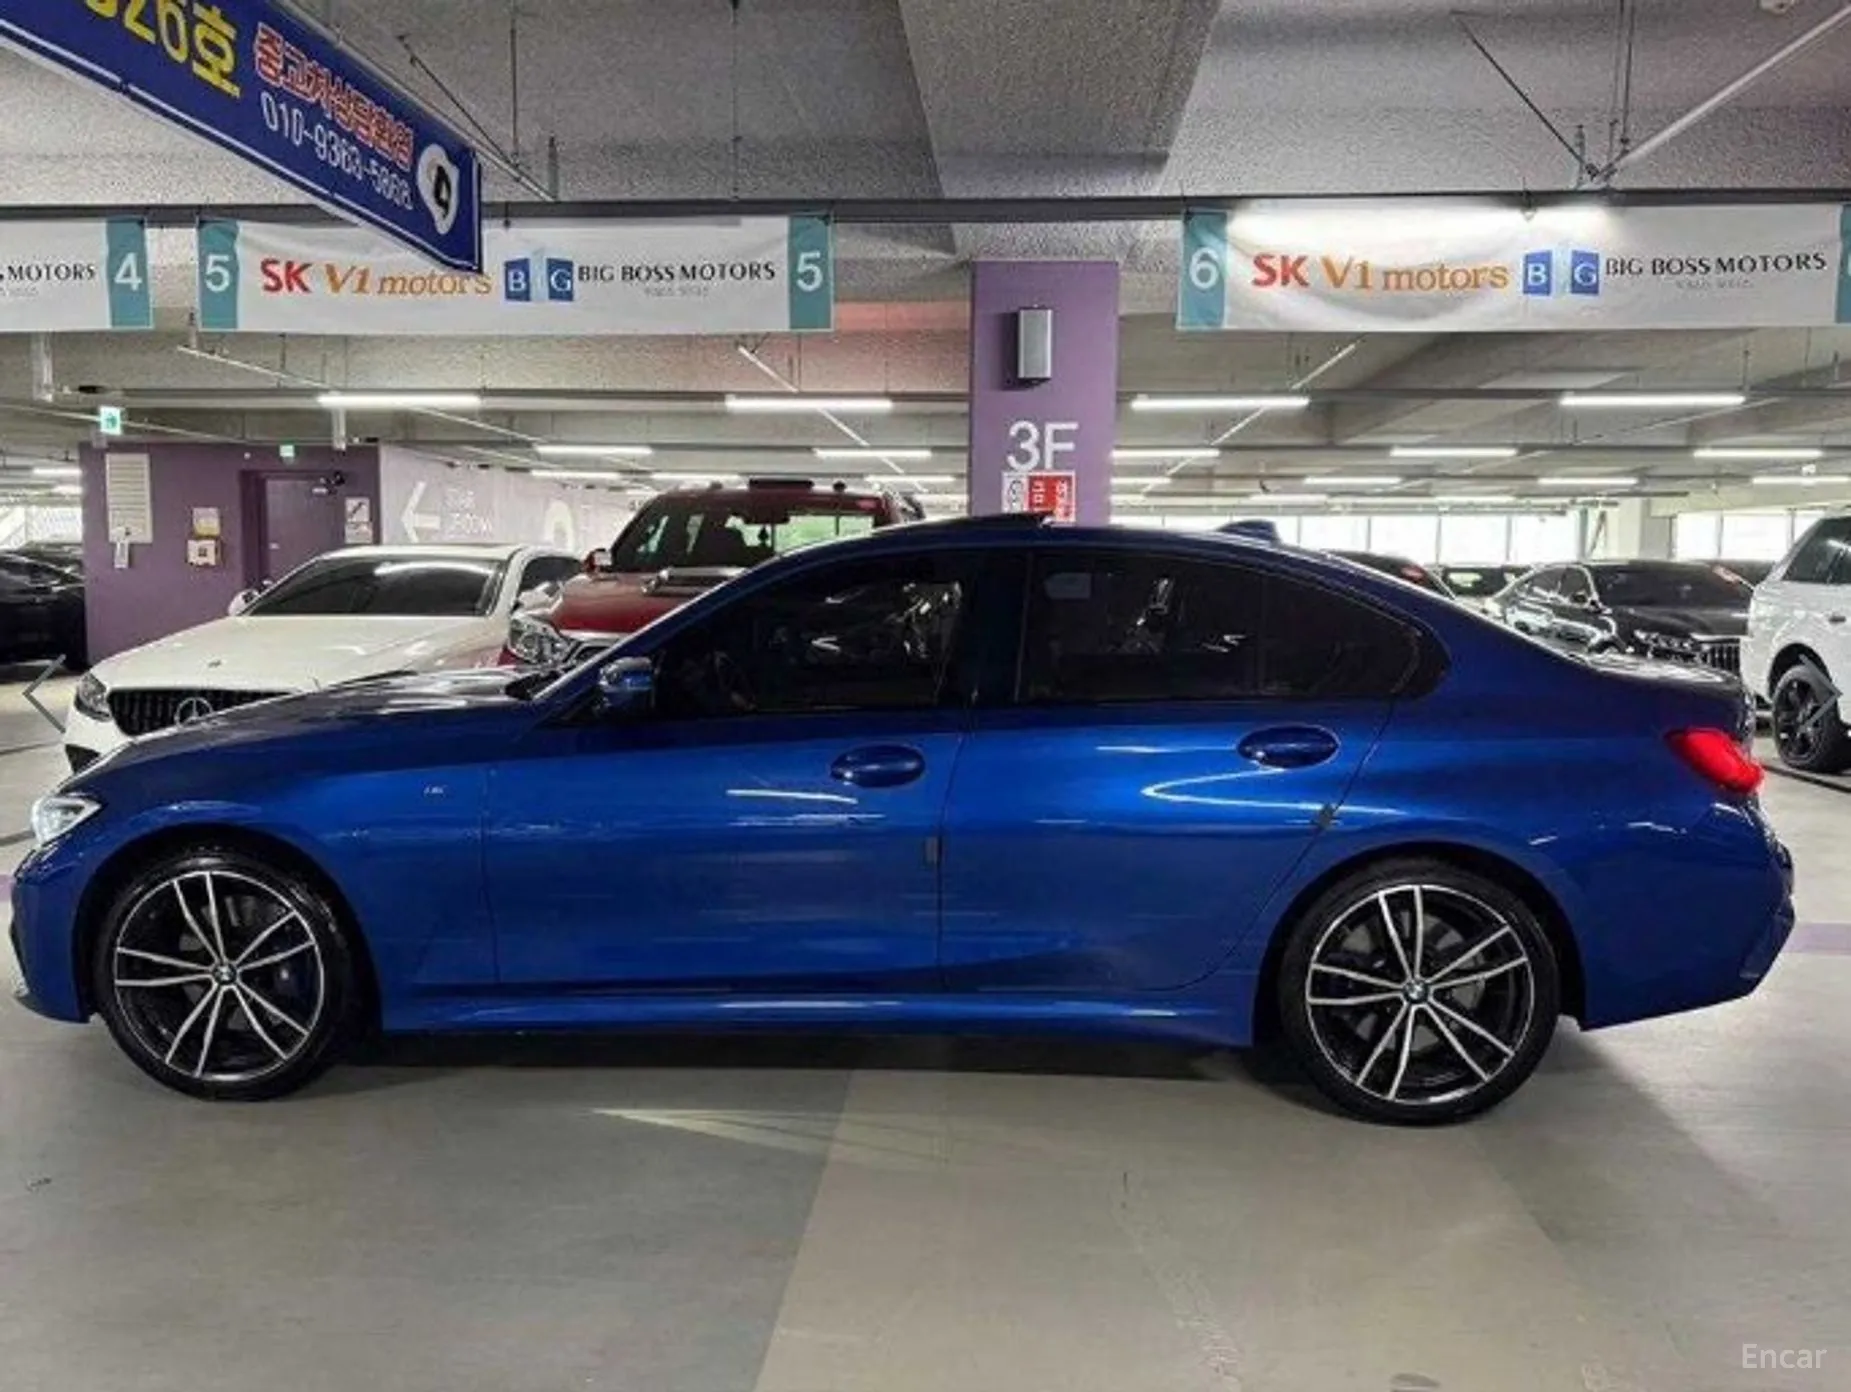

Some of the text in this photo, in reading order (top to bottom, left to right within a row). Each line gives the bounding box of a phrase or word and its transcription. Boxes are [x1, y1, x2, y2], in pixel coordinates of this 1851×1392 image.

[7, 263, 96, 282] MOTORS
[114, 252, 143, 291] 4
[204, 254, 231, 293] 5
[260, 257, 313, 294] SK
[325, 264, 370, 295] V1
[578, 261, 777, 282] BIG BOSS MOTORS
[797, 251, 822, 292] 5
[1189, 246, 1220, 290] 6
[1252, 253, 1509, 291] SK V1 motors
[1605, 258, 1643, 276] BIG
[1651, 257, 1711, 276] BOSS
[1716, 252, 1827, 274] MOTORS
[1006, 419, 1078, 471] 3F
